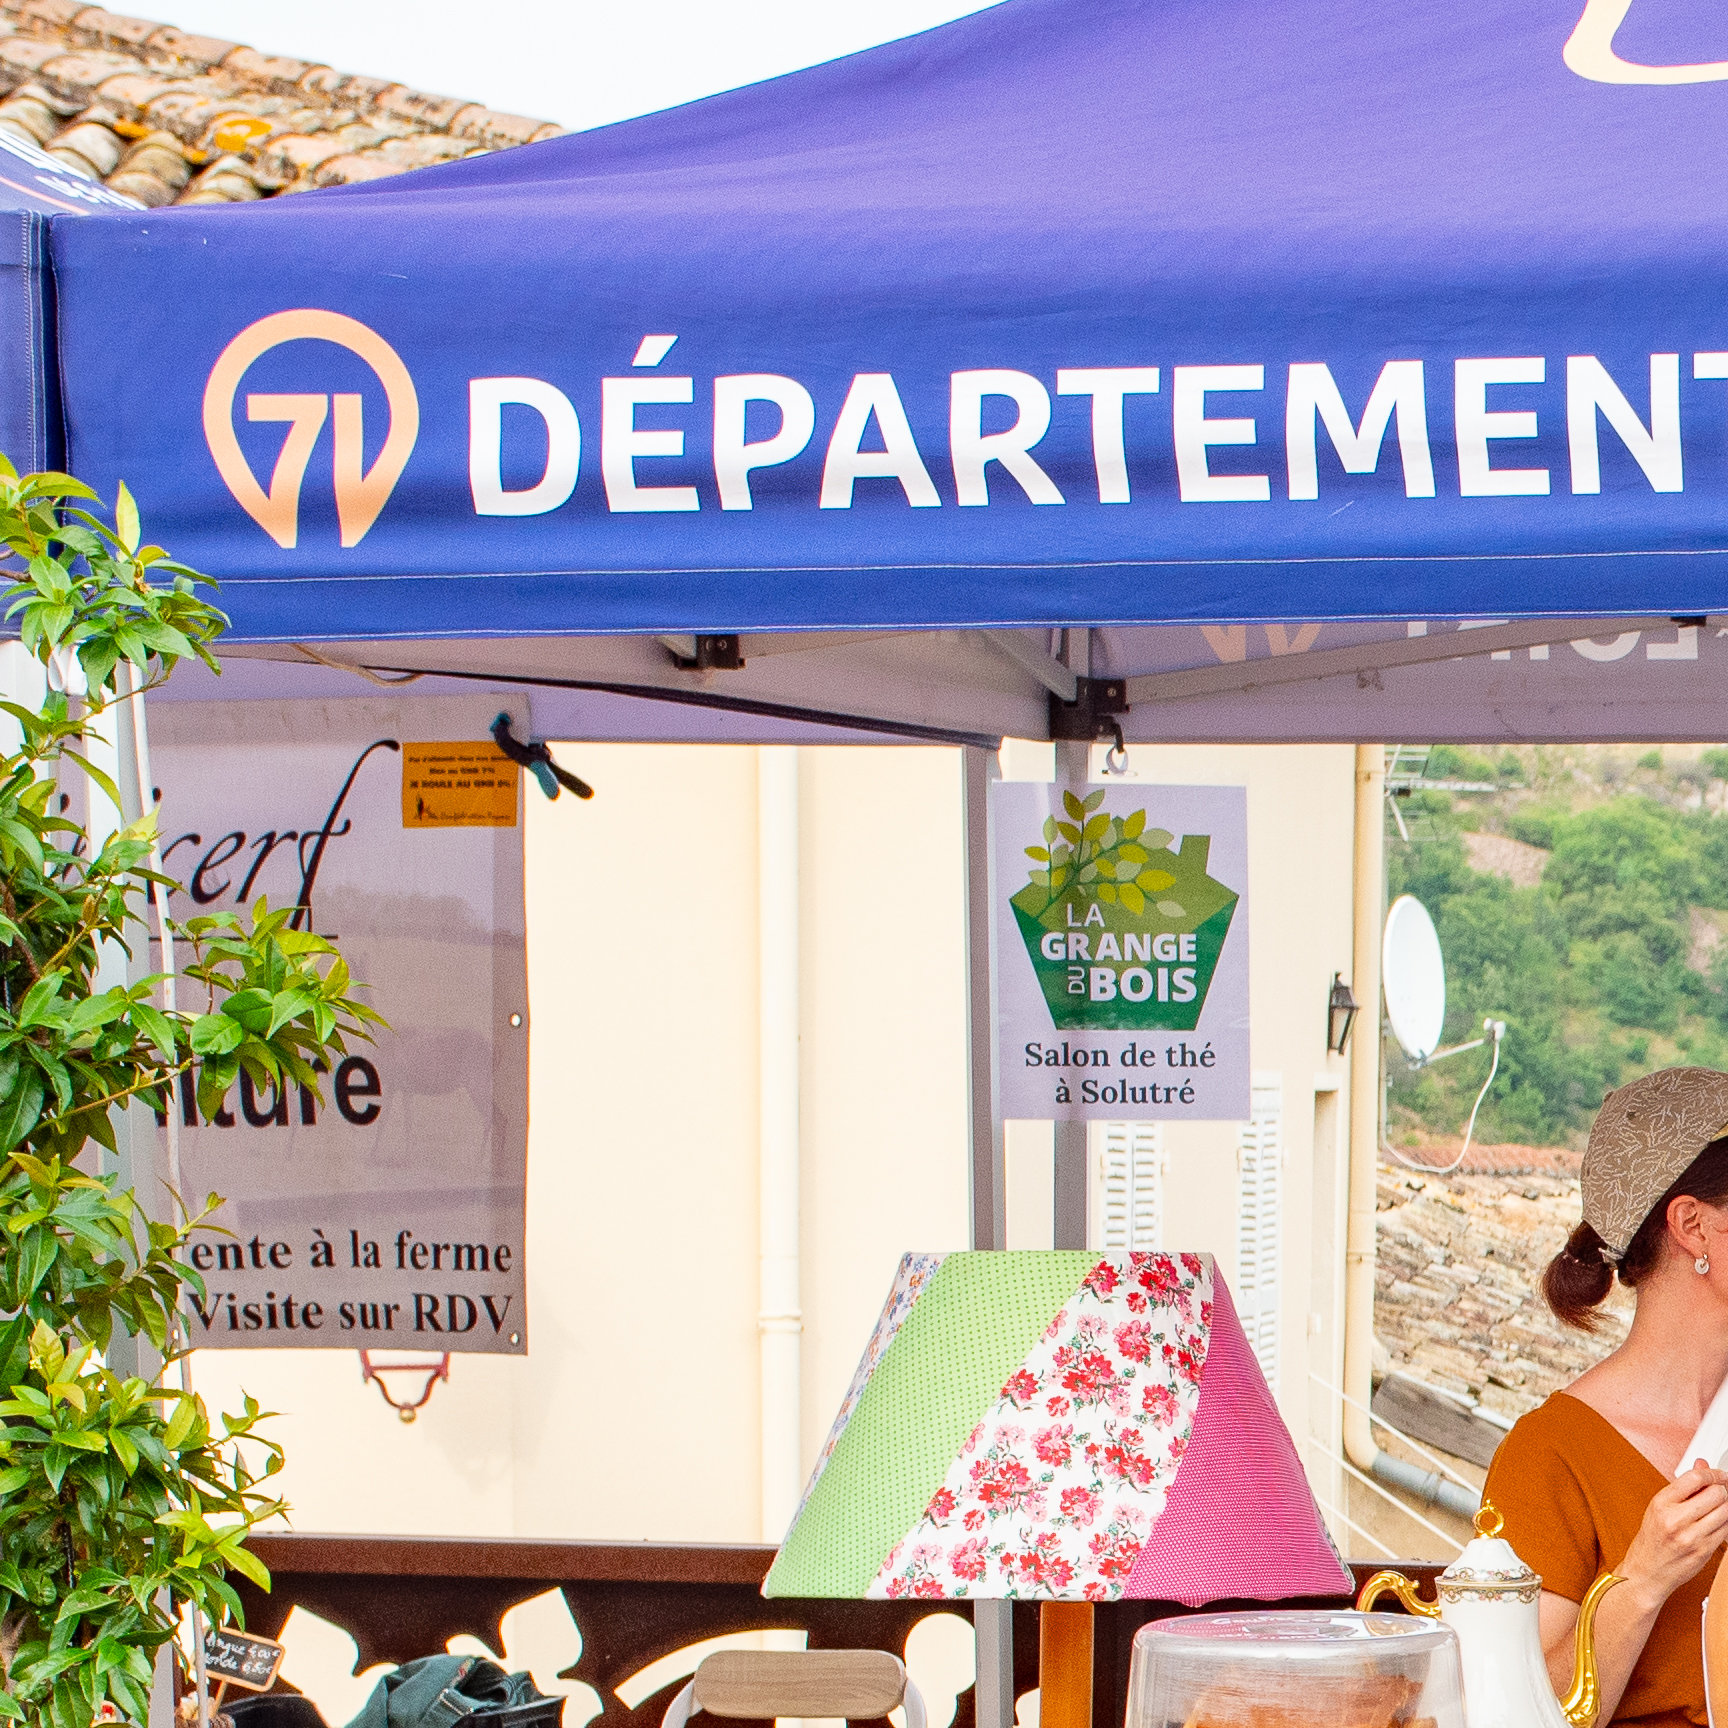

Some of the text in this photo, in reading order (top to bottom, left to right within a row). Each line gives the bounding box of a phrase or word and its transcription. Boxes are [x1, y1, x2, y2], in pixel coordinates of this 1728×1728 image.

[1067, 903, 1105, 928] LA
[1041, 933, 1197, 962] GRANGE
[1067, 966, 1197, 1002] DU BOIS
[1025, 1042, 1216, 1068] Salon de thé
[1054, 1078, 1195, 1104] à Solutré
[191, 1230, 512, 1273] ente à la ferme
[189, 1291, 512, 1334] Visite sur RDV
